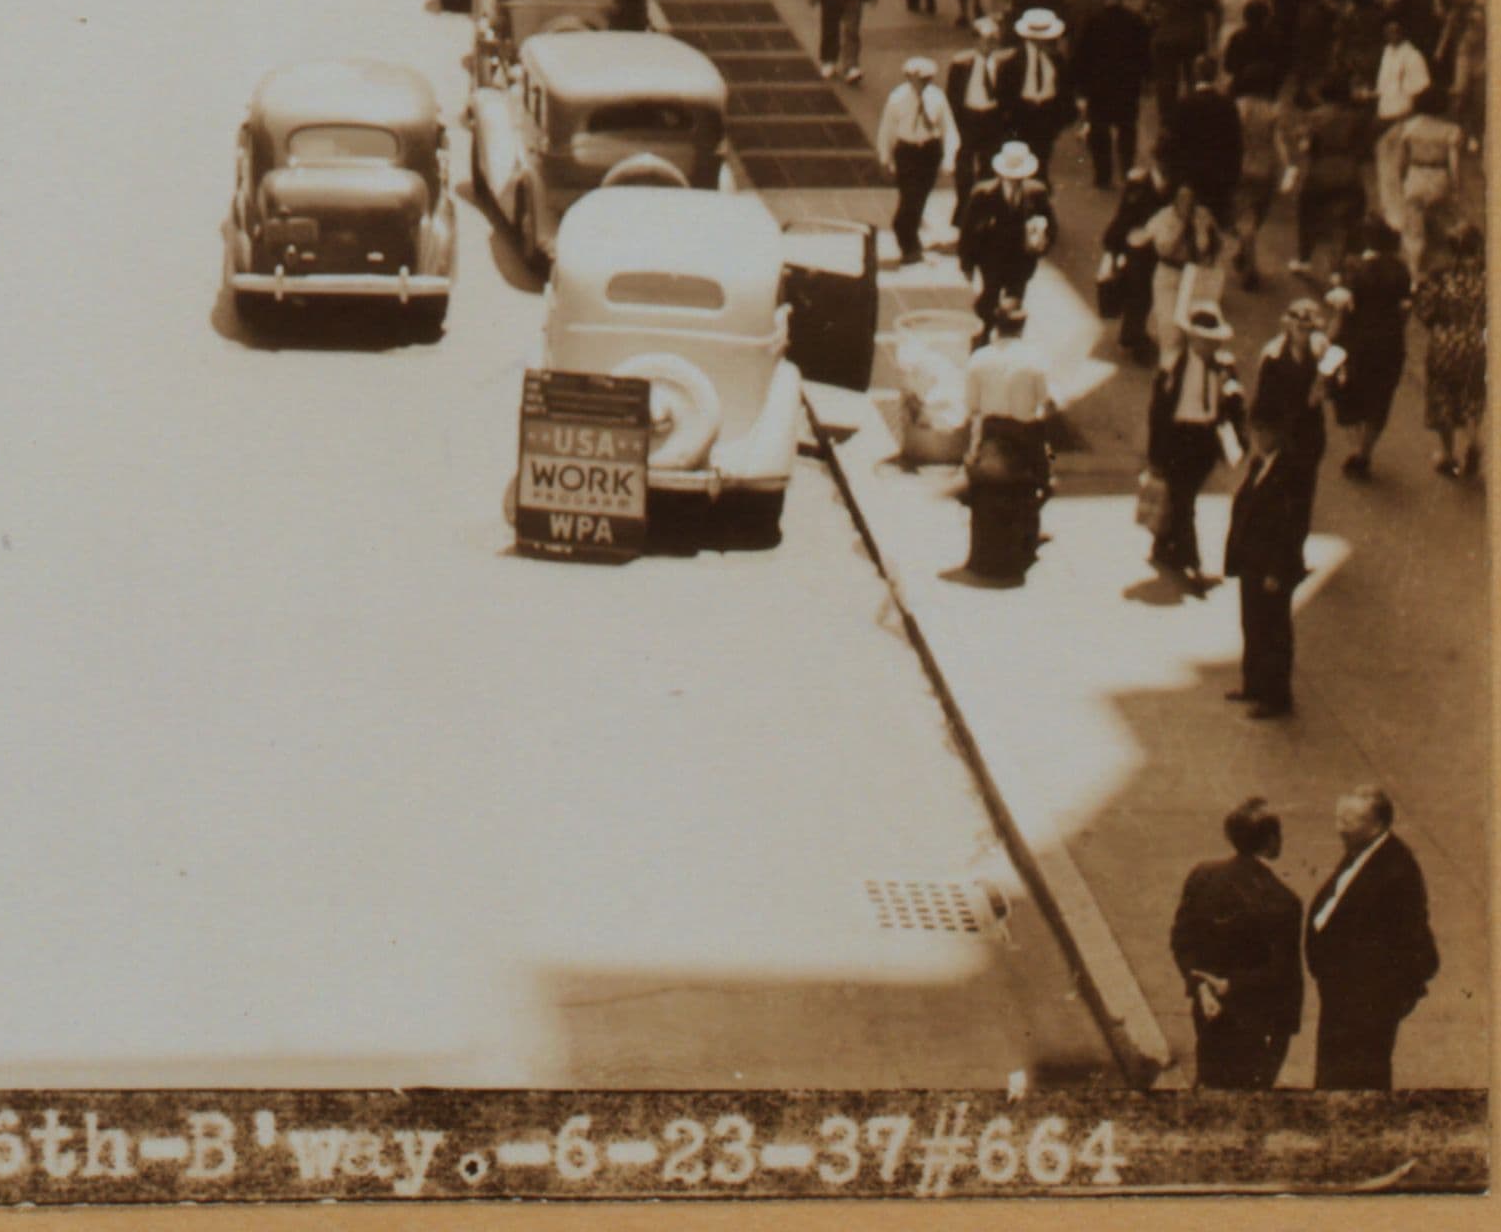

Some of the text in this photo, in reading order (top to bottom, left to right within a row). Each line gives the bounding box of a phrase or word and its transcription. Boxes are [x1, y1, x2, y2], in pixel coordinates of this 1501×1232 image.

[553, 426, 615, 458] USA
[530, 460, 634, 497] WORK
[548, 512, 614, 545] WPA
